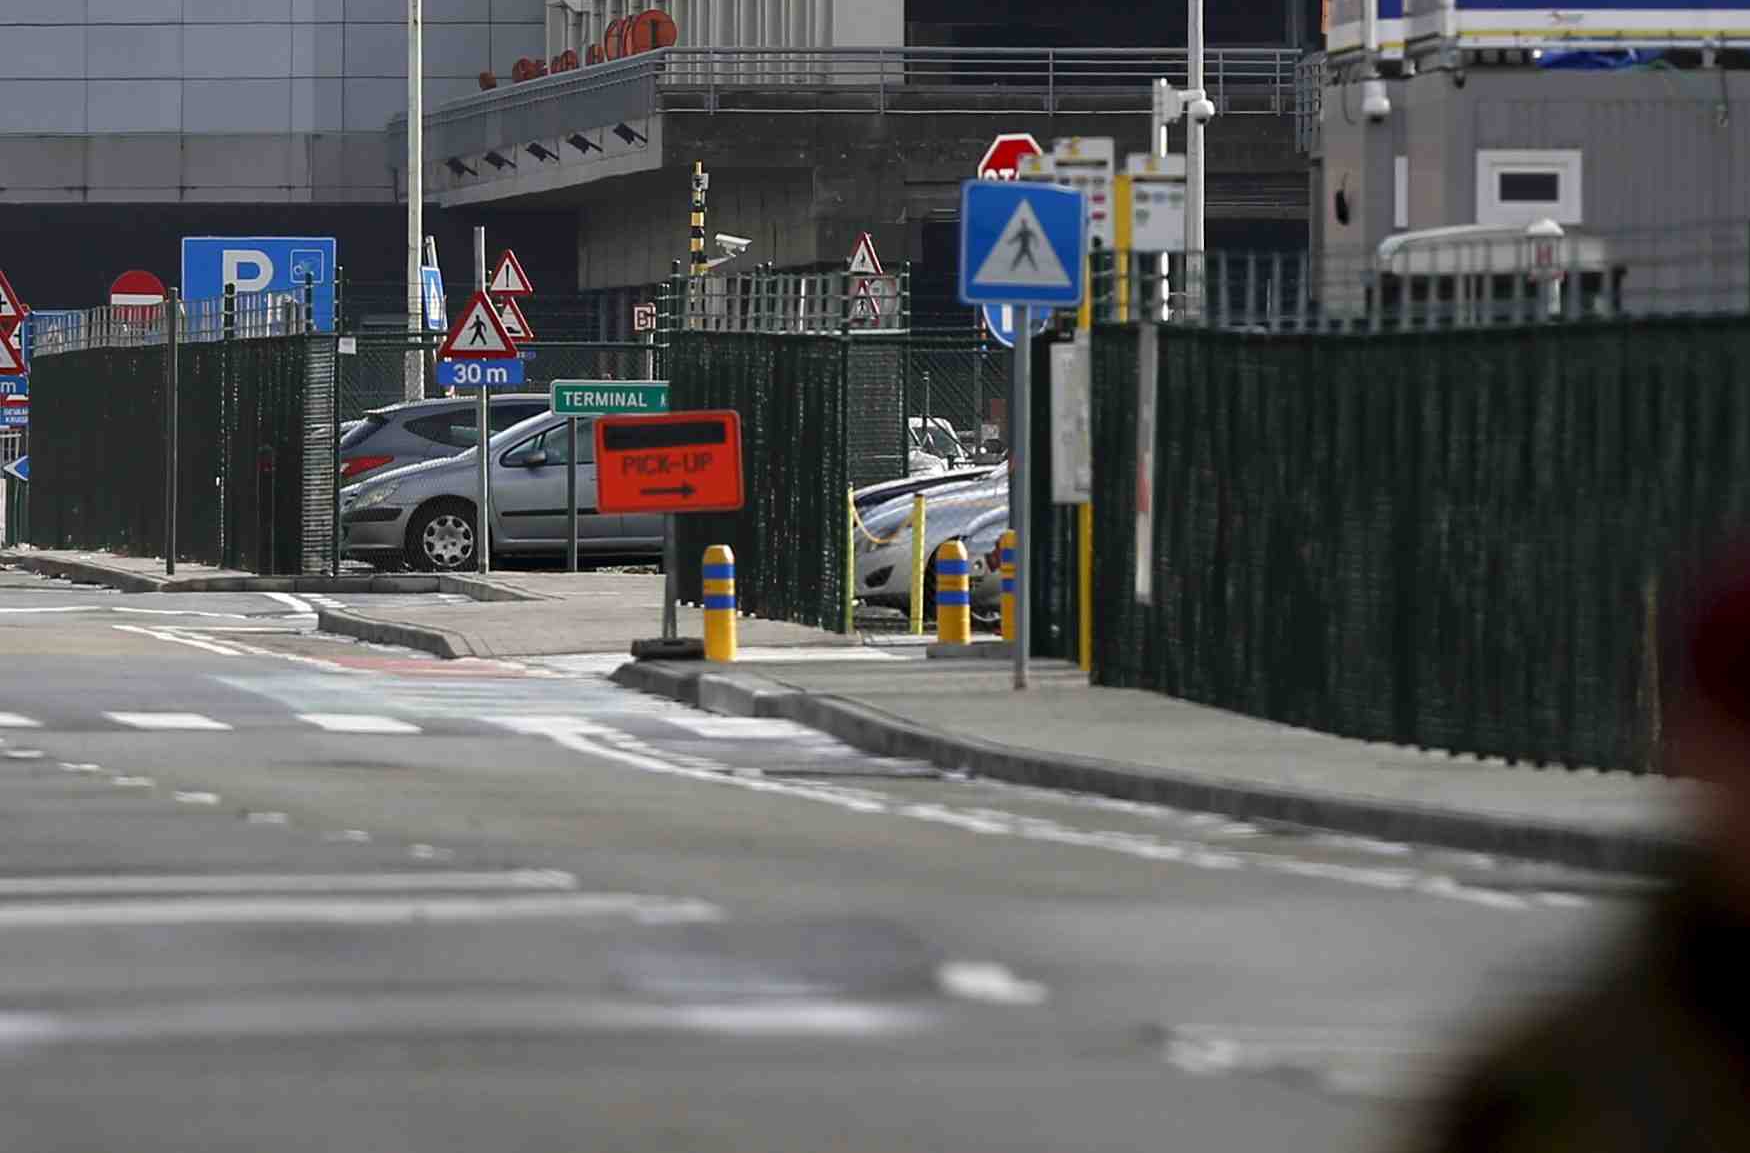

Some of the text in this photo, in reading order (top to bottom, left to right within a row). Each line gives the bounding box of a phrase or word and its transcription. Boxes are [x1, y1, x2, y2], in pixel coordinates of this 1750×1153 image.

[222, 250, 274, 317] P
[452, 363, 508, 384] 30 m
[563, 391, 647, 408] TERMINAL
[621, 452, 714, 477] PICK-UP
